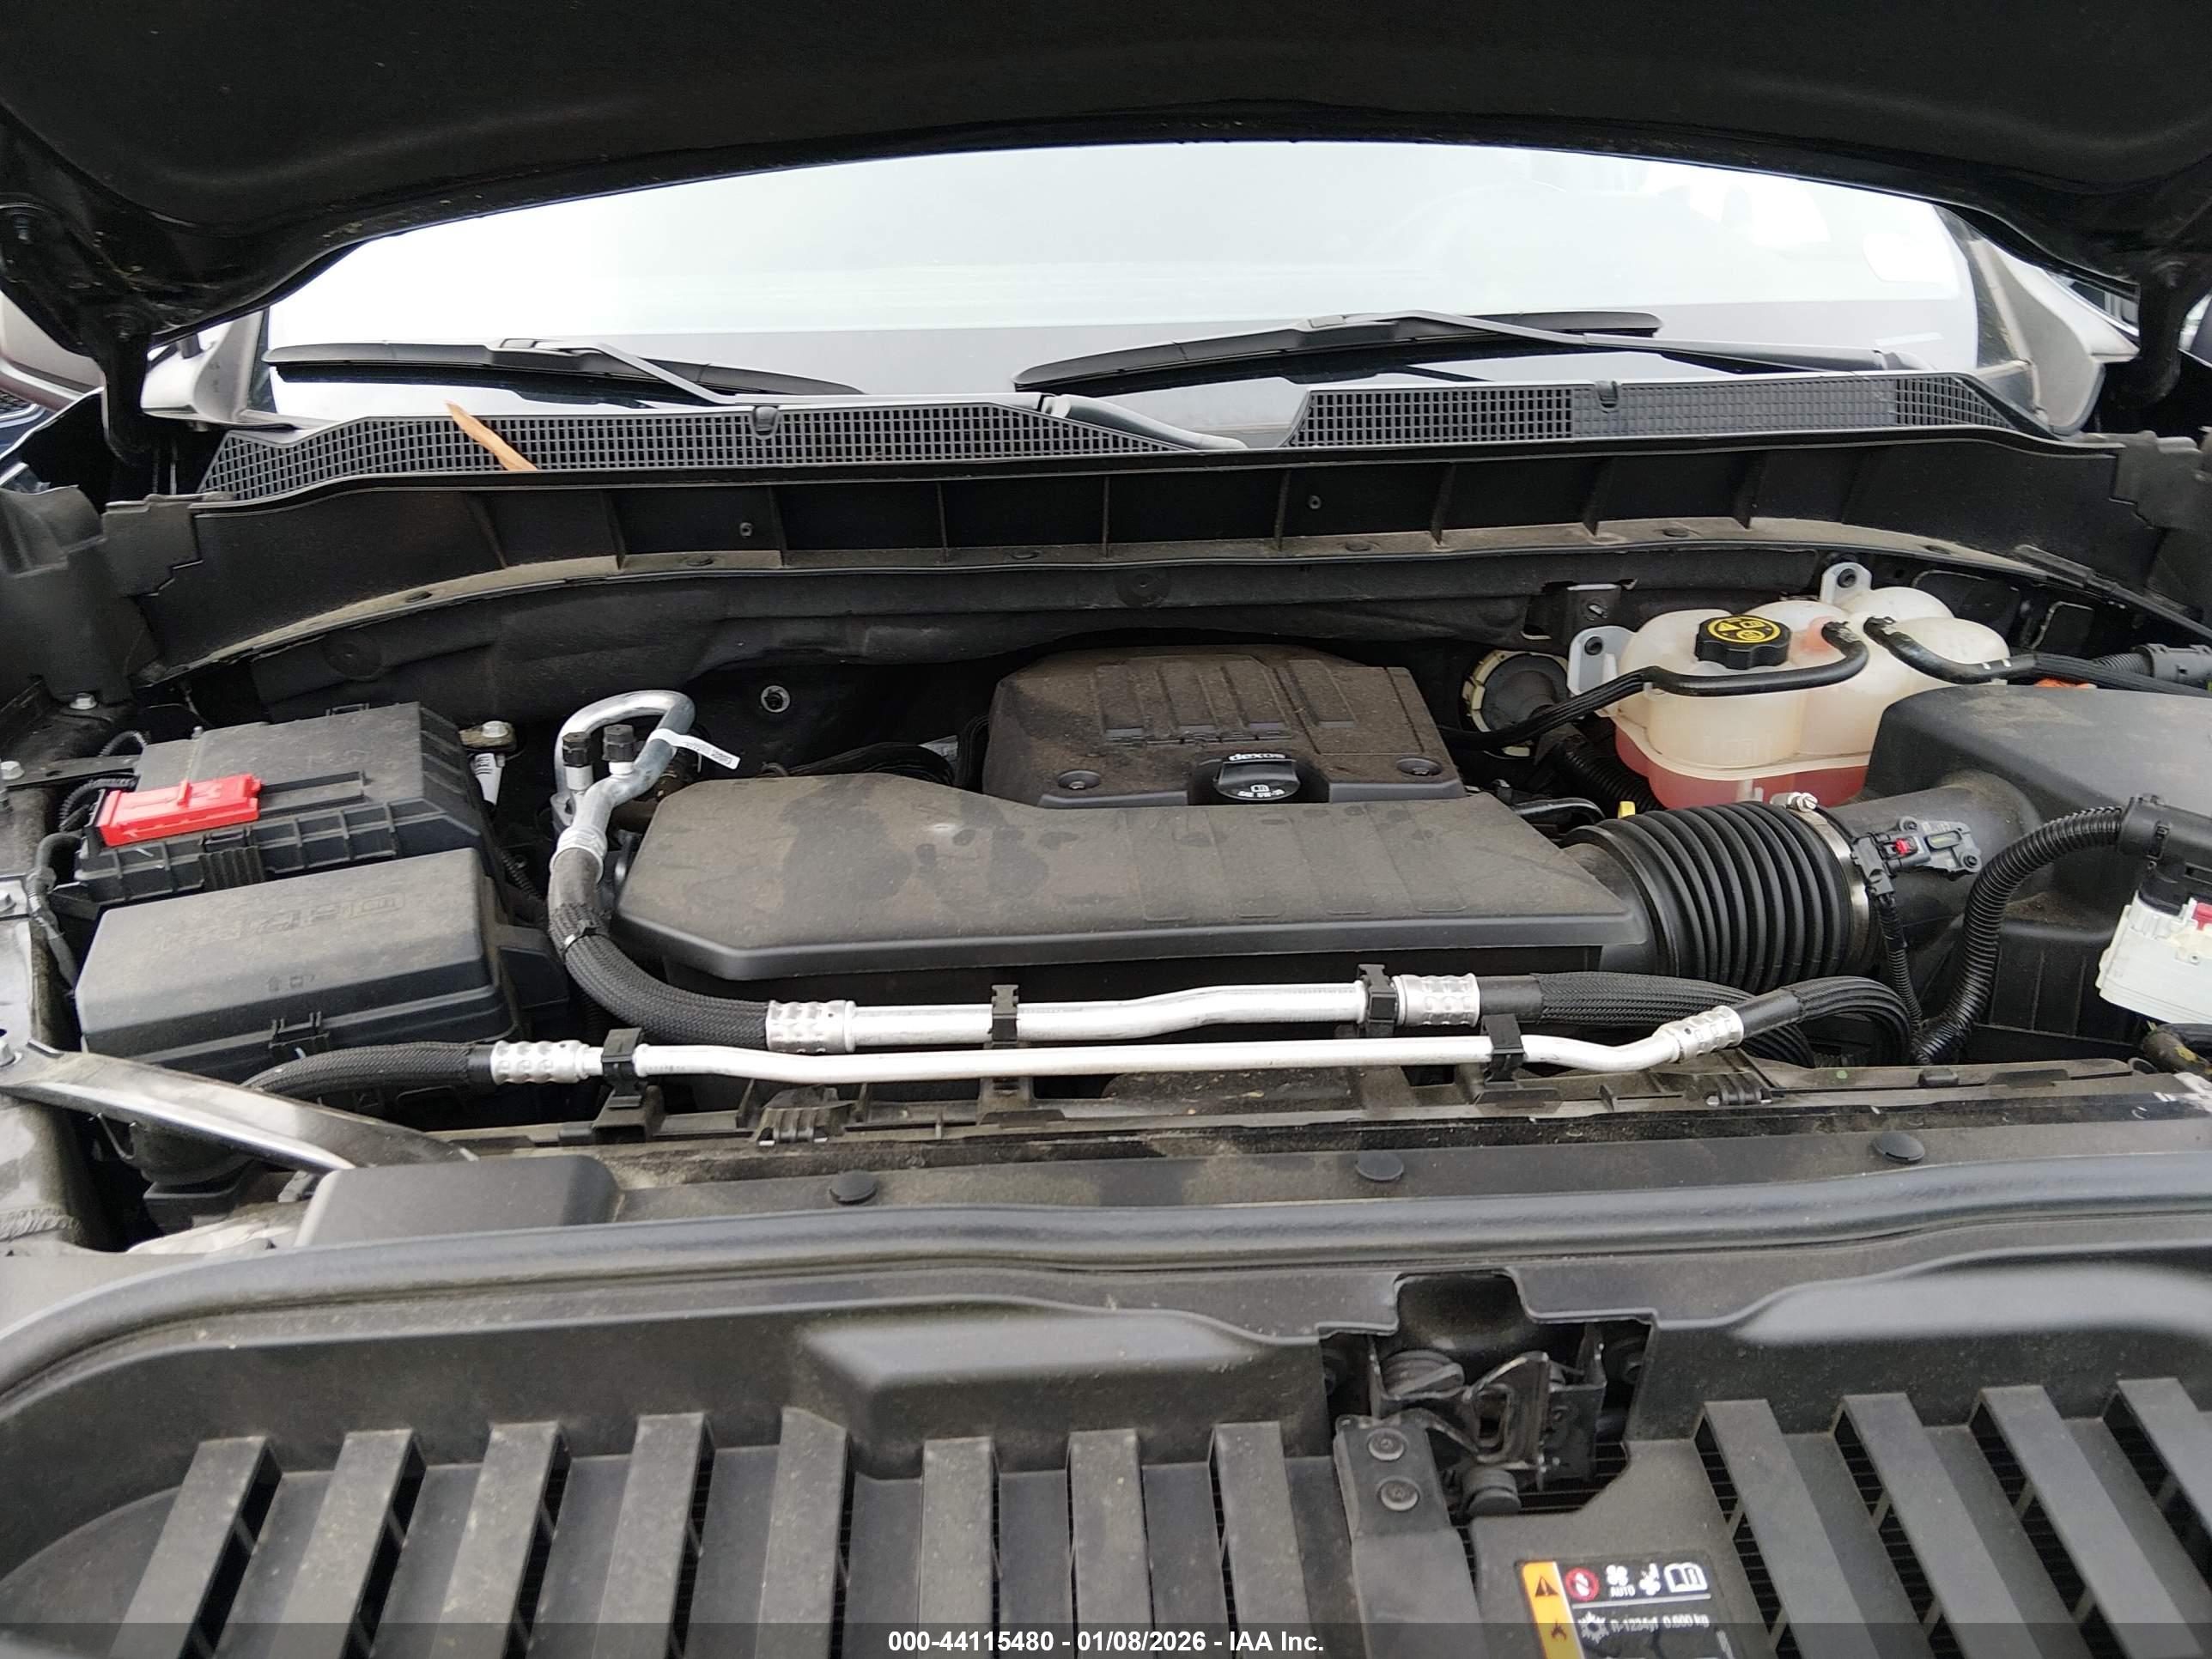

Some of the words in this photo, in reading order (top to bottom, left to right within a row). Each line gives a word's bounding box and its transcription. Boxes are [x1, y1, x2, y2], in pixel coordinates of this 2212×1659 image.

[1229, 753, 1285, 762] dexos
[1610, 1585, 1636, 1597] AUTO
[1693, 1613, 1710, 1628] kg
